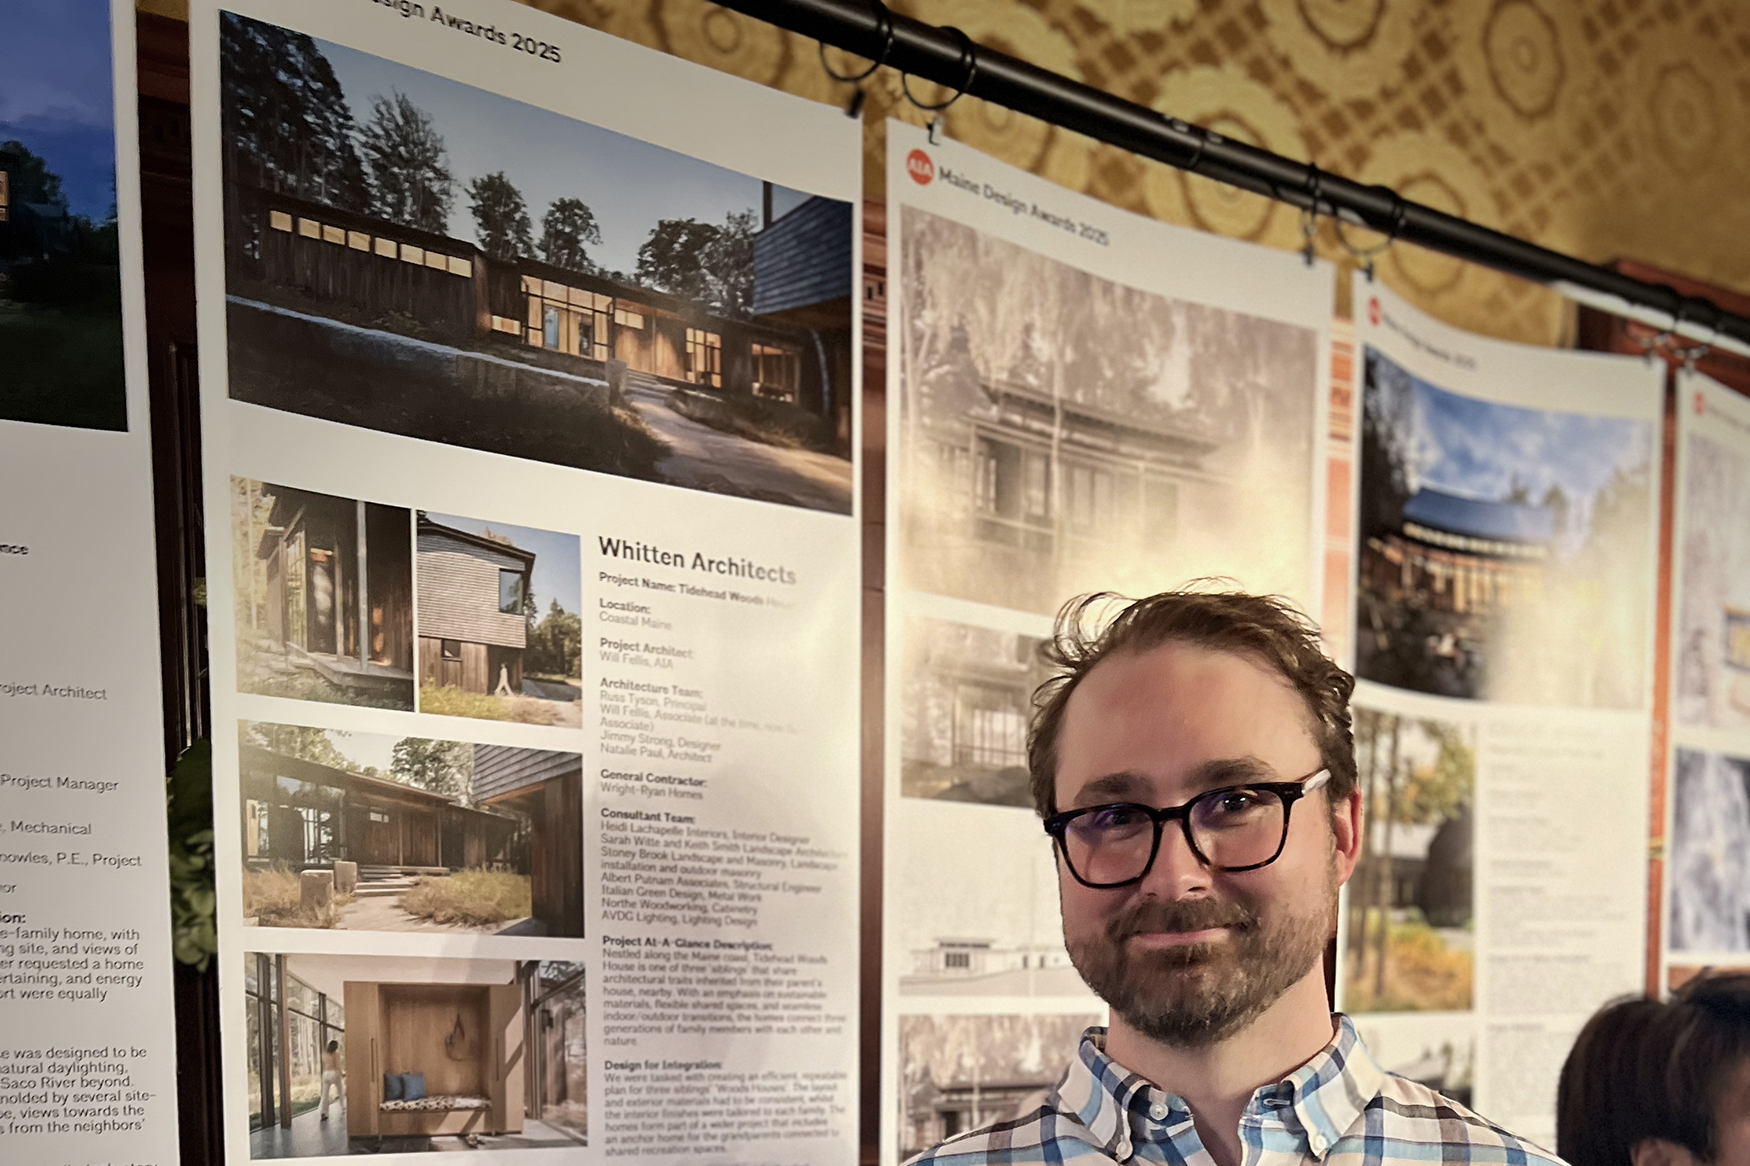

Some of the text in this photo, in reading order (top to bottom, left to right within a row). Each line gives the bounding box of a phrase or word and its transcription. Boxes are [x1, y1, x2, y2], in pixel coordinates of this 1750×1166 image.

[372, 0, 562, 63] sign Awards 2025
[939, 167, 980, 194] Maine
[984, 184, 1027, 215] Design
[1032, 204, 1076, 234] Awards
[1079, 223, 1109, 246] 2025
[598, 536, 796, 585] Whitten Architects
[599, 572, 639, 586] Project
[642, 578, 676, 592] Name:
[679, 583, 727, 600] Tidehead
[729, 591, 764, 605] Woods
[600, 598, 651, 614] Location:
[599, 611, 672, 630] Coastal Maine
[600, 637, 640, 652] Project
[600, 651, 673, 669] Will Fellis, AIA
[42, 684, 107, 700] Architect
[600, 678, 703, 698] Architecture Team:
[600, 690, 707, 712] Russ Tyson, Principal
[600, 703, 702, 723] Will Fellis, Associate
[600, 717, 654, 732] Associate)
[601, 730, 721, 752] Jimmy Strong, Designer
[601, 743, 712, 762] Natalie Paul, Architect
[0, 774, 119, 793] Project Manager
[601, 769, 707, 787] General Contractor:
[601, 782, 703, 800] Wright-Ryan Homes
[601, 808, 695, 824] Consultant Team:
[11, 820, 91, 835] Mechanical
[601, 821, 627, 832] Heidi
[630, 823, 684, 837] Lachapelle
[57, 852, 142, 869] P.E., Project
[602, 885, 633, 896] Italian
[636, 886, 666, 897] Green
[708, 891, 734, 900] Metal
[640, 900, 708, 914] Woodworking,
[637, 912, 679, 926] Lighting,
[682, 914, 721, 927] Lighting
[724, 916, 757, 928] Design
[63, 928, 140, 941] home, with
[19, 943, 139, 956] site, and views of
[602, 935, 642, 948] Project
[713, 939, 773, 951] Description:
[18, 958, 144, 972] requested a home
[66, 973, 143, 988] and energy
[20, 988, 108, 1002] were equally
[14, 1047, 147, 1061] was designed to be
[47, 1061, 128, 1077] daylighting,
[604, 1060, 723, 1073] Design for Integration:
[0, 1075, 134, 1090] Saco River beyond.
[52, 1089, 156, 1106] by several site-
[20, 1105, 144, 1119] views towards the
[9, 1122, 43, 1134] from
[47, 1121, 70, 1132] the
